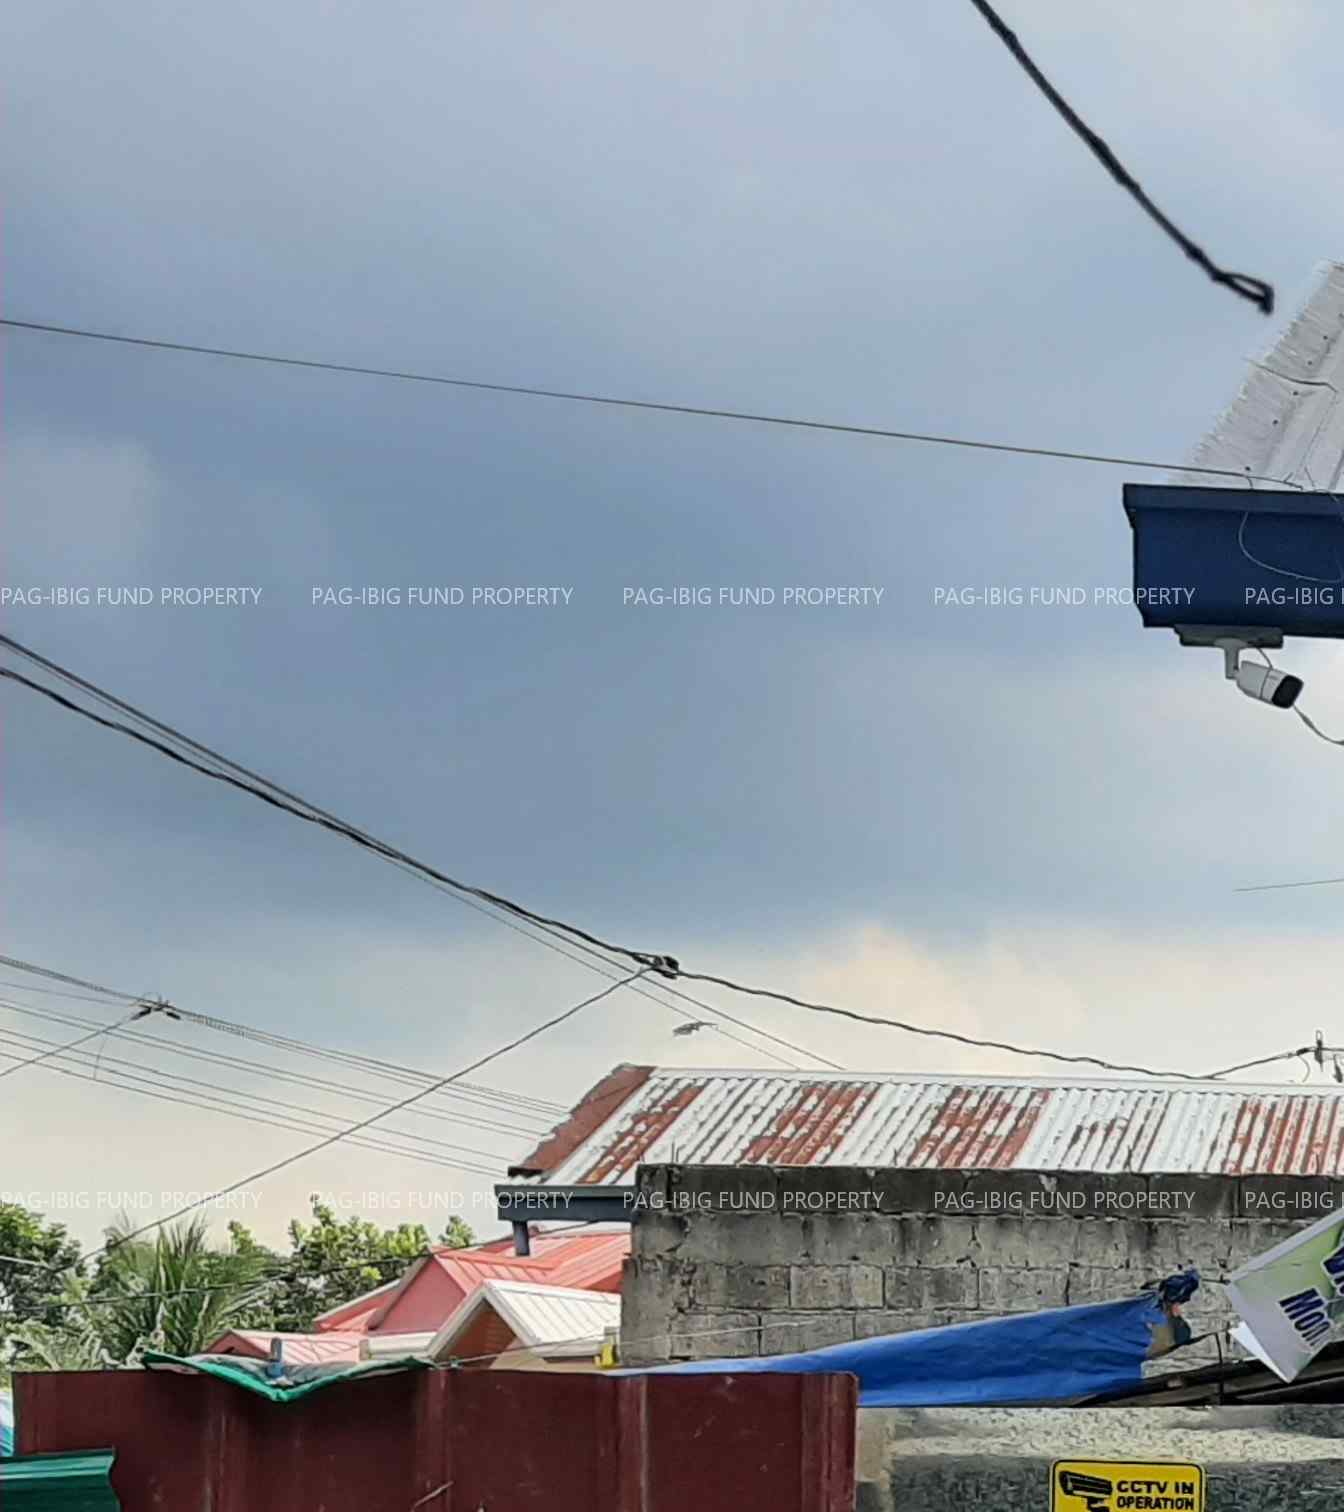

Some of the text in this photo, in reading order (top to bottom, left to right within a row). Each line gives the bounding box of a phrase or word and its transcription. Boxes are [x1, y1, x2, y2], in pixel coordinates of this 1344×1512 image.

[1116, 1480, 1194, 1495] CCTV IN
[1116, 1495, 1194, 1511] OPERATION
